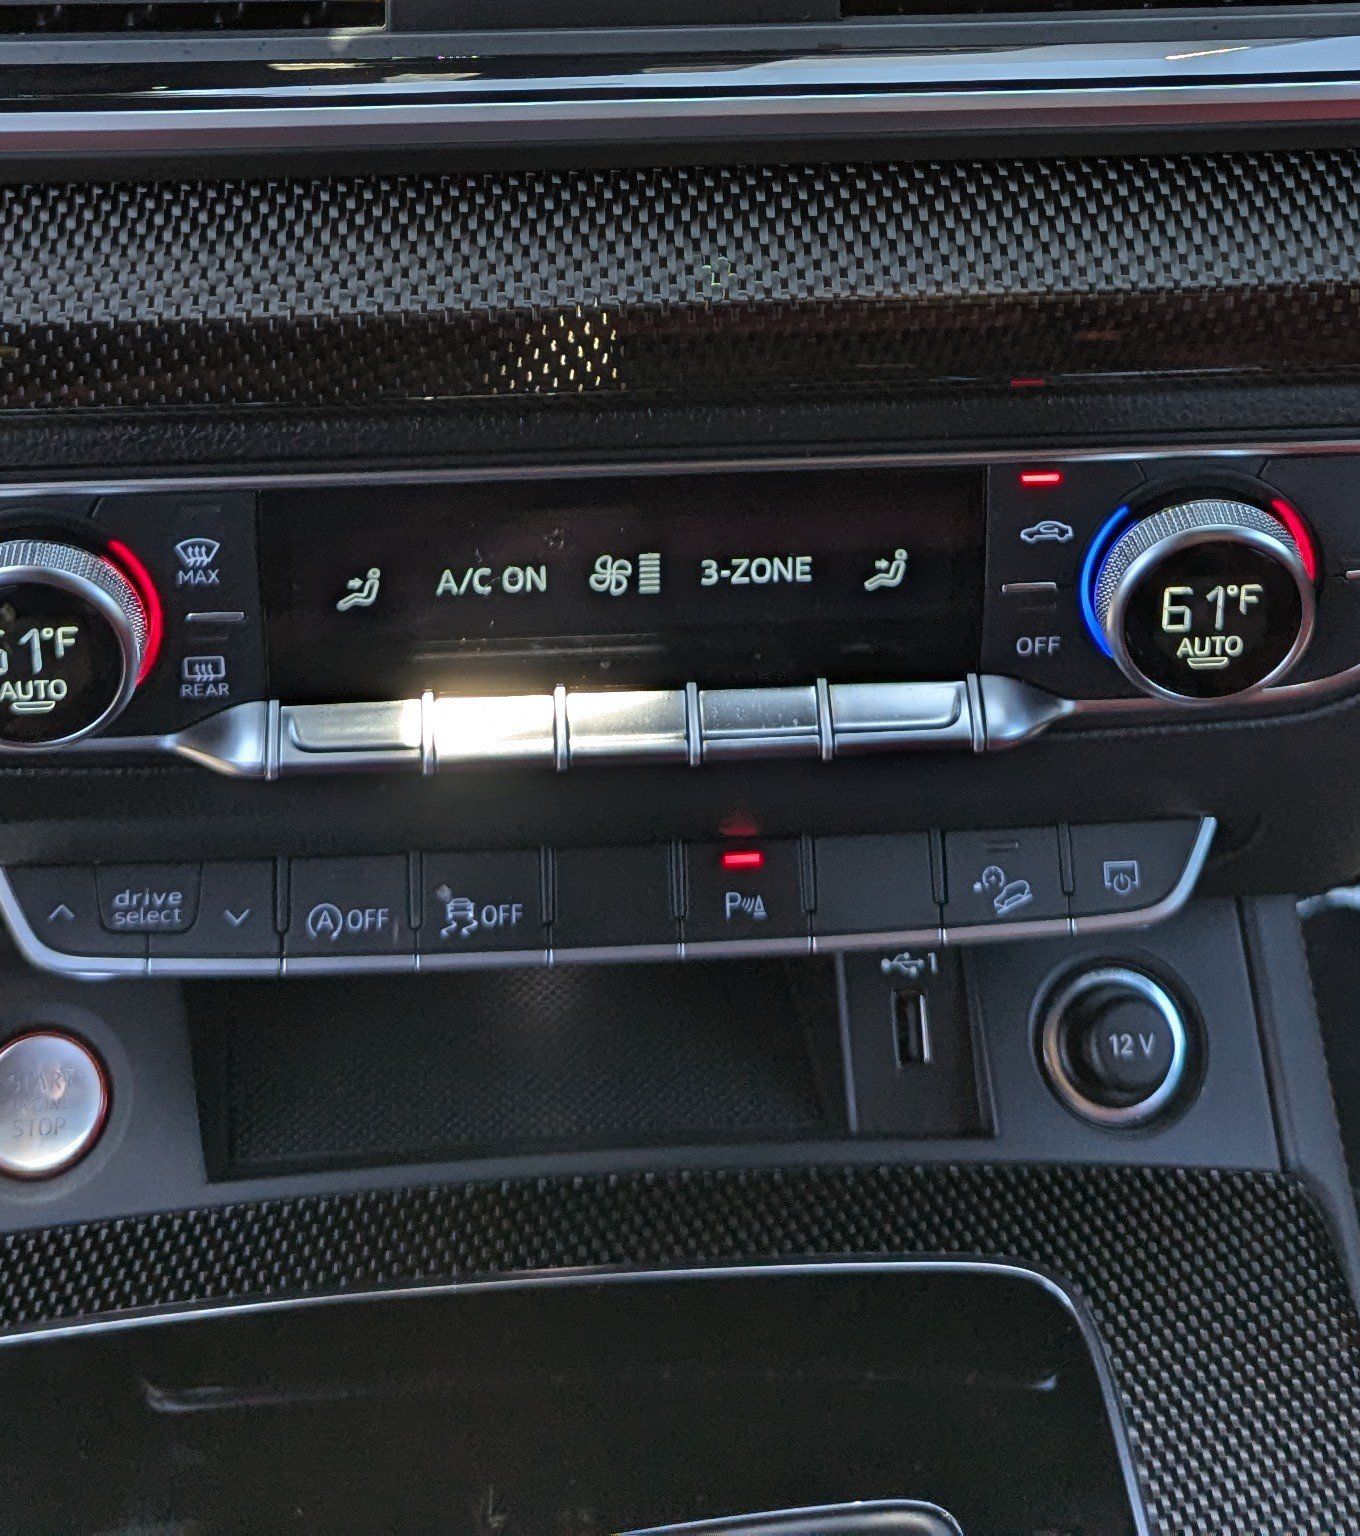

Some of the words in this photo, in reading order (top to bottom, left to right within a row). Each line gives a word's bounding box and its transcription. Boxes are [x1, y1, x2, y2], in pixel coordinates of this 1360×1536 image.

[177, 570, 220, 585] MAX
[436, 567, 492, 596] A/C
[501, 566, 547, 593] ON
[701, 557, 813, 586] 3-ZONE
[1016, 636, 1061, 656] OFF
[1176, 635, 1243, 658] AUTO
[180, 682, 230, 698] REAR
[113, 888, 183, 909] drive
[113, 907, 182, 926] select
[348, 908, 389, 930] OFF
[482, 904, 523, 927] OFF
[1108, 1033, 1133, 1057] 12
[1138, 1033, 1155, 1057] V
[13, 1117, 67, 1137] STOP
